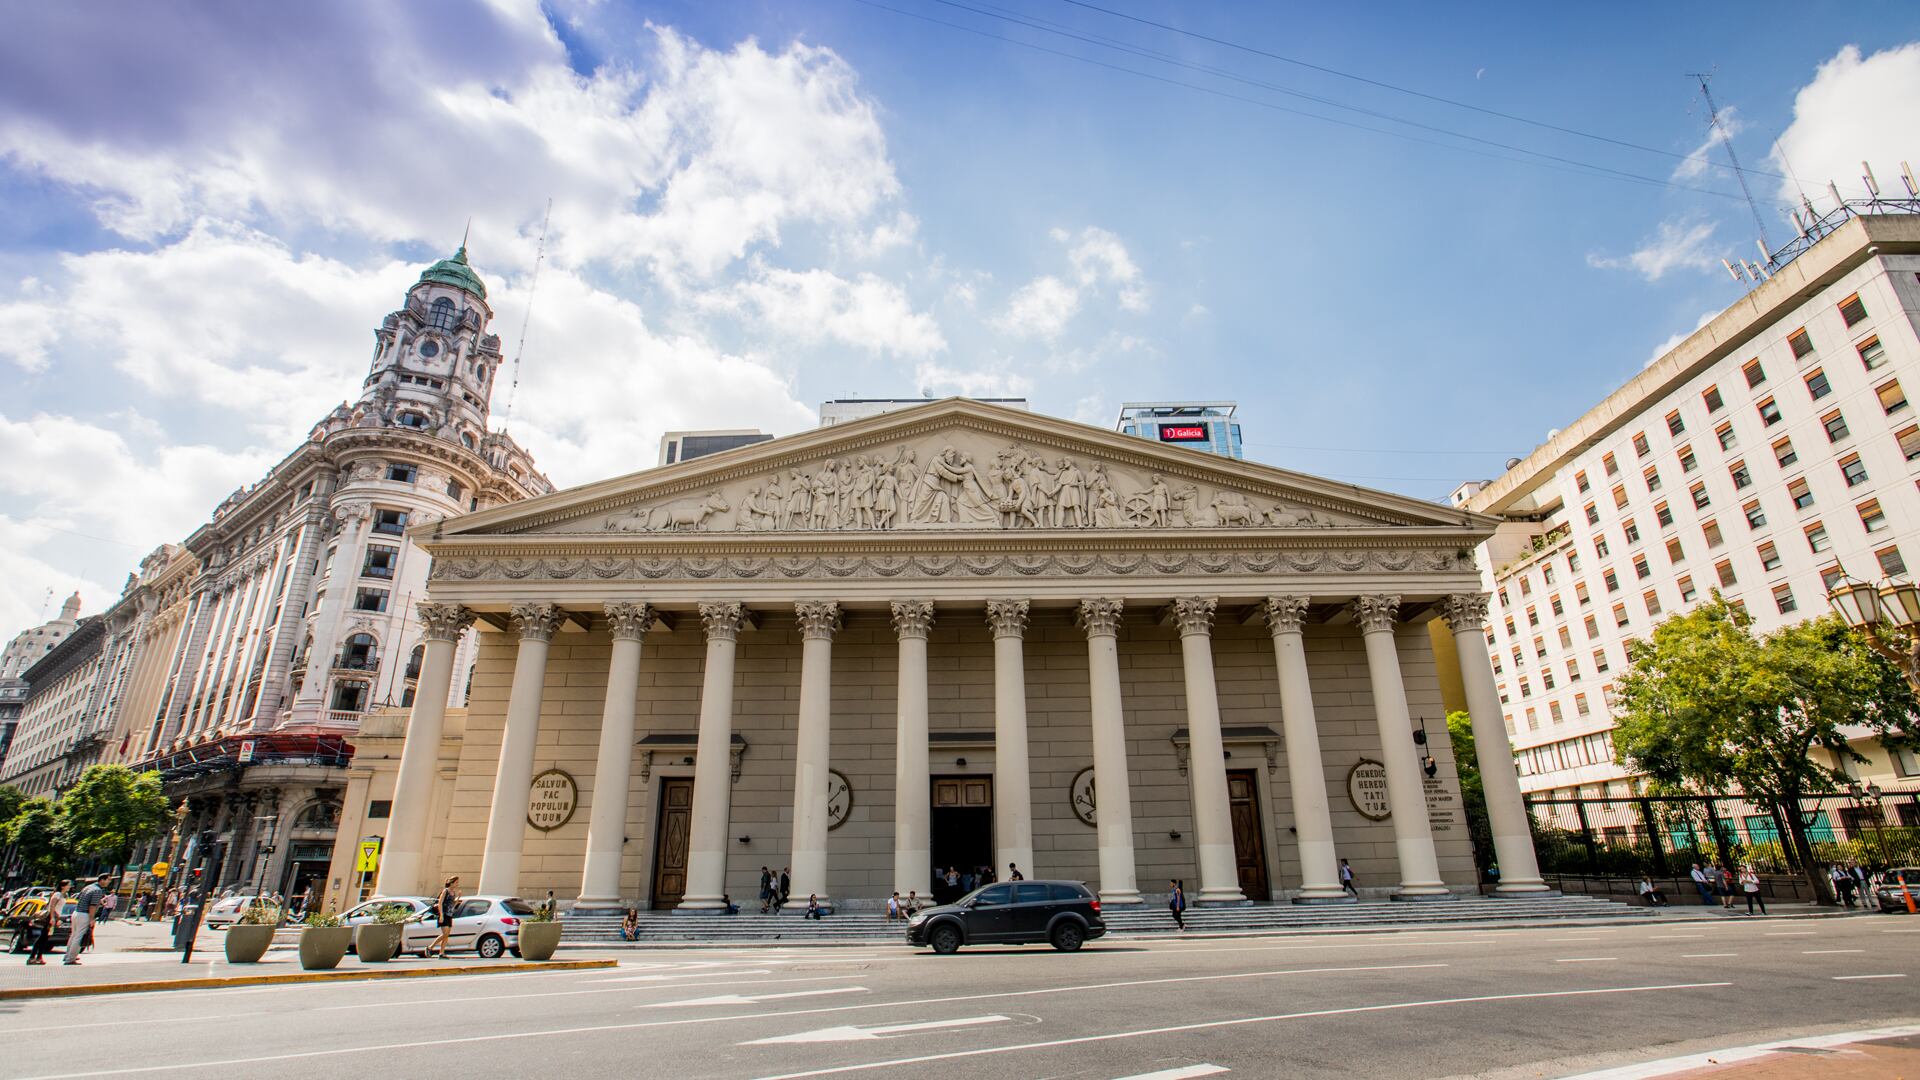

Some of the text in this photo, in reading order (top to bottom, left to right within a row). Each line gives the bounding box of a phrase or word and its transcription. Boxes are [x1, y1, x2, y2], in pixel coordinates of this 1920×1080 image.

[1177, 429, 1201, 437] Galicia
[1356, 769, 1386, 778] BENEDIC
[536, 780, 567, 788] SALVUM
[1358, 780, 1387, 789] HEREDI
[543, 790, 559, 799] FAC
[1363, 791, 1384, 800] TATI
[530, 802, 569, 811] POPULUM
[535, 813, 562, 822] TUUM
